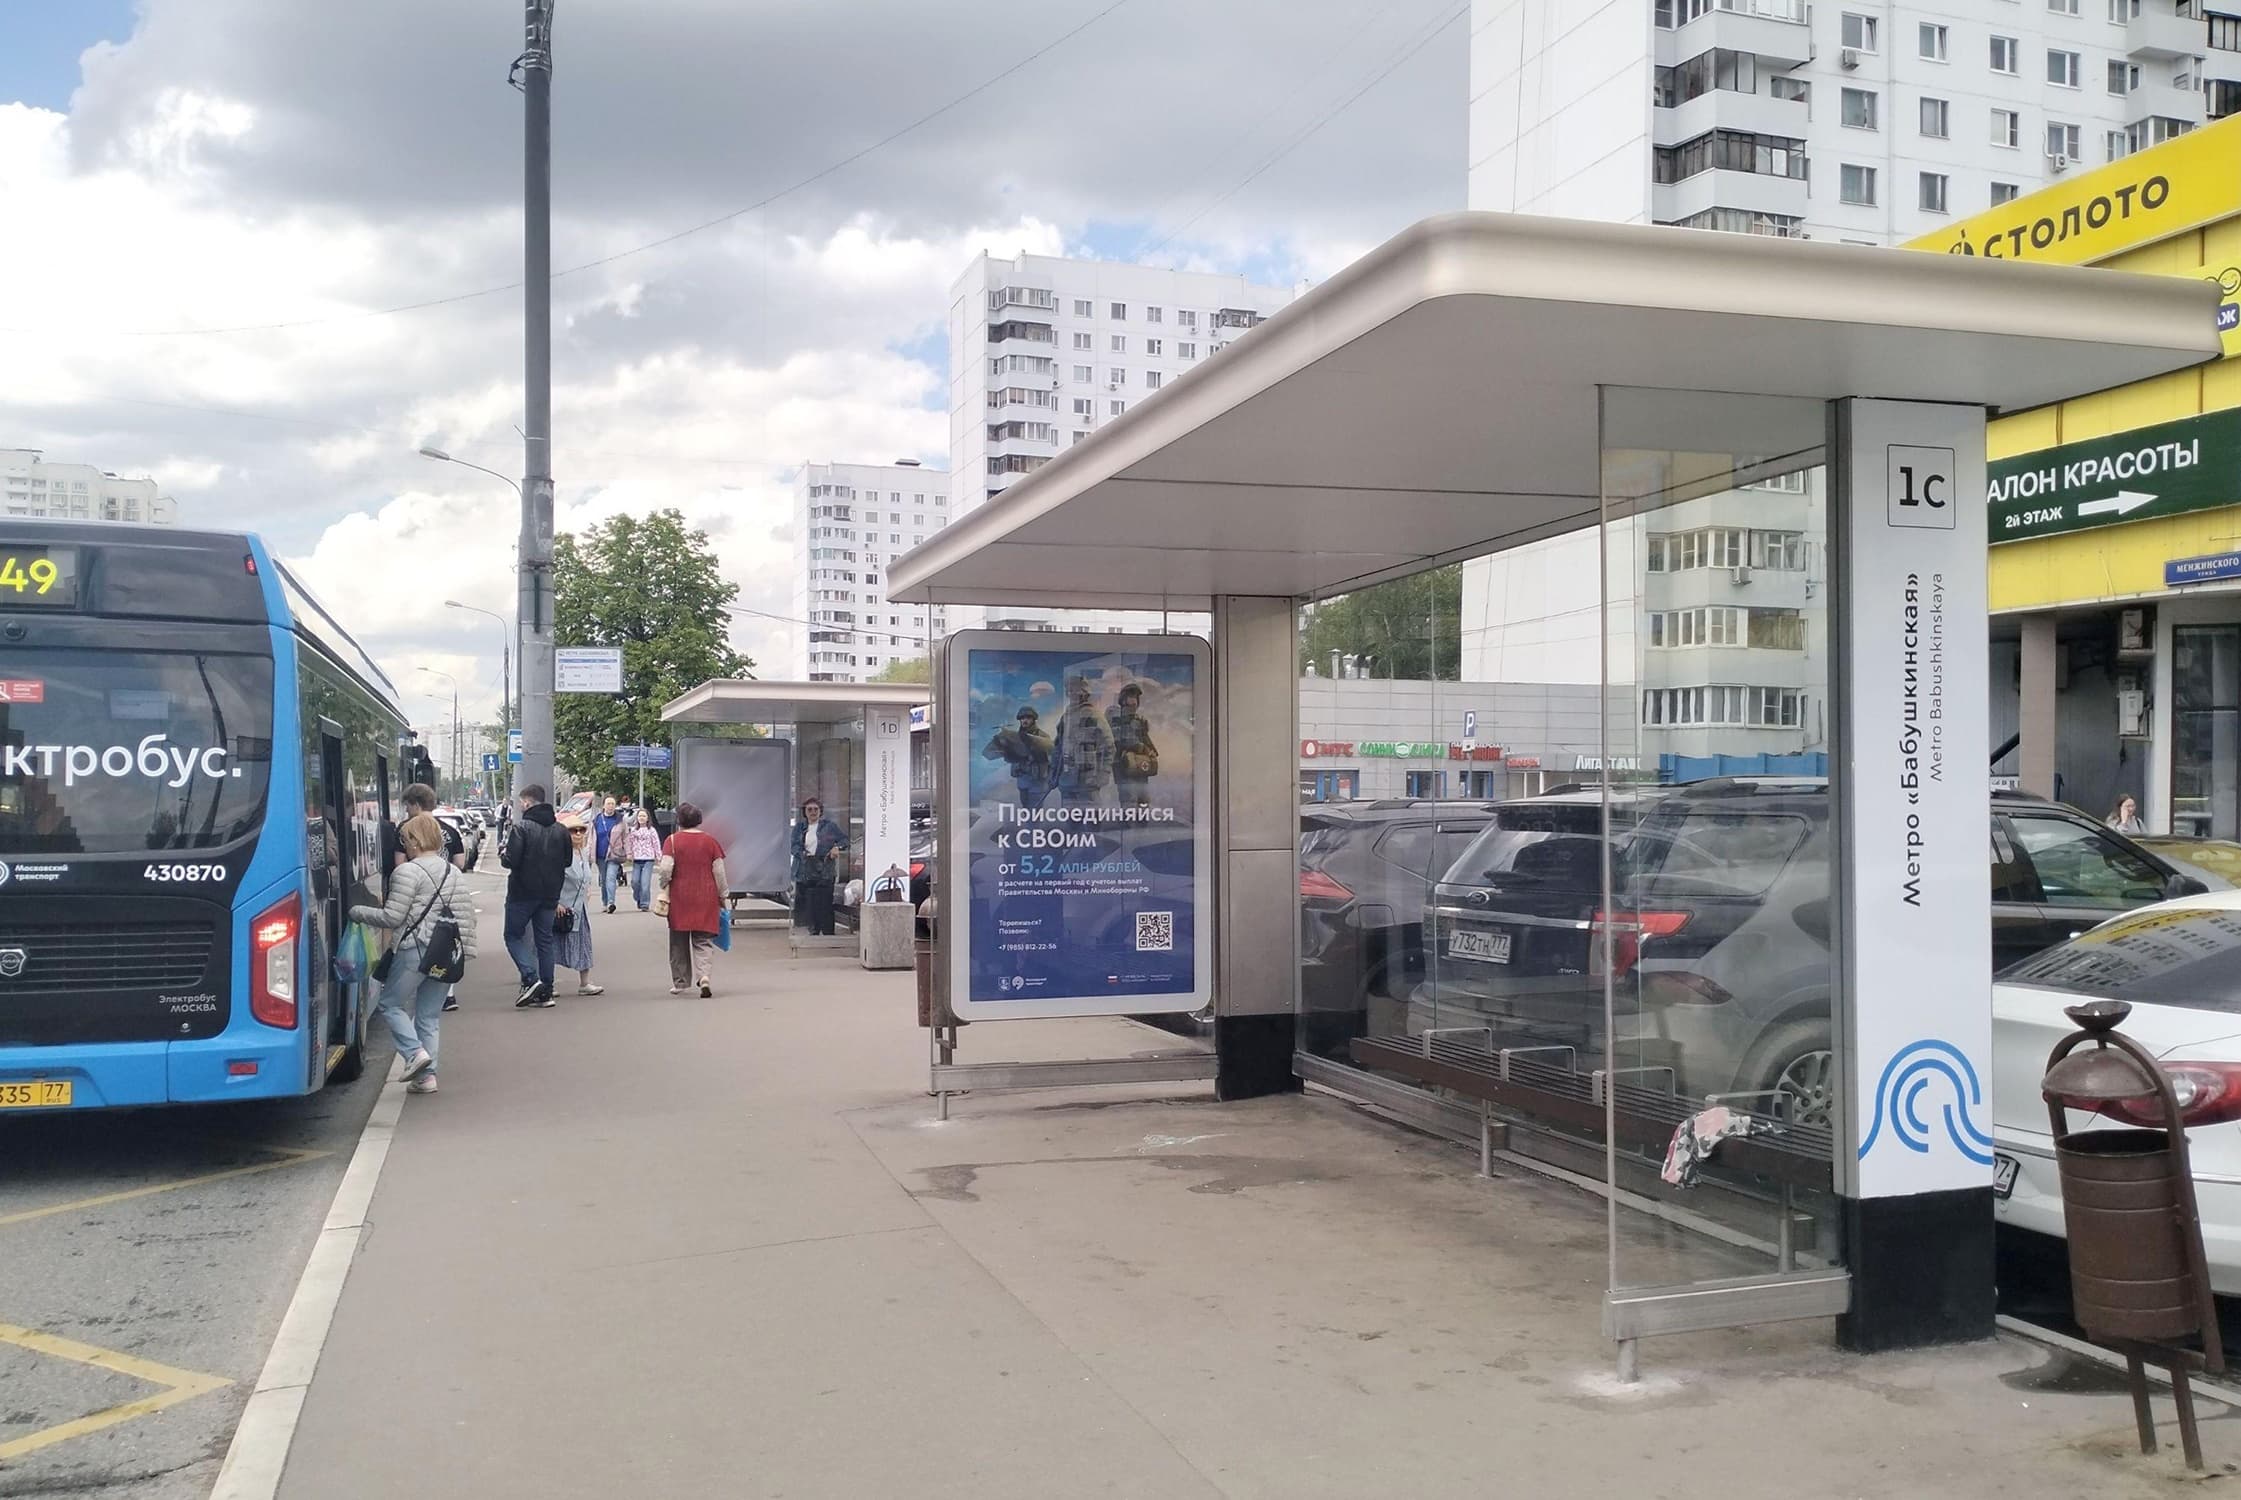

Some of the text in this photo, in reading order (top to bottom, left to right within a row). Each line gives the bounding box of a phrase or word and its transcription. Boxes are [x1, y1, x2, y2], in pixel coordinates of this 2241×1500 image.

[1984, 175, 2169, 258] СТОЛОТО
[2064, 439, 2199, 488] КРАСОТЫ
[2005, 506, 2063, 528] 2й ЭТАЖ
[2176, 557, 2239, 573] МЕНЖИНСКОГО
[0, 558, 57, 594] 49
[1929, 572, 1944, 782] Metro Babushkinskaya
[880, 721, 898, 734] 1D
[1900, 572, 1924, 907] Метро «Бабушкинская»
[4, 733, 241, 788] ктробус.
[999, 802, 1174, 826] Присоединяйся
[998, 829, 1097, 849] к СВОим
[15, 864, 69, 873] Московский
[143, 864, 226, 882] 430870
[998, 855, 1141, 878] от 5,2 МЛН РУБЛЕЙ
[14, 873, 60, 882] транспорт
[1004, 880, 1033, 888] расчете
[1044, 878, 1072, 888] первый
[1072, 879, 1084, 888] год
[998, 888, 1053, 897] Правительства
[1053, 888, 1083, 896] Москвы
[1090, 887, 1138, 896] Минобороны
[1138, 885, 1150, 893] РФ
[159, 993, 216, 1004] Электробус
[170, 1003, 217, 1013] МОСКВА
[44, 1083, 65, 1098] 77
